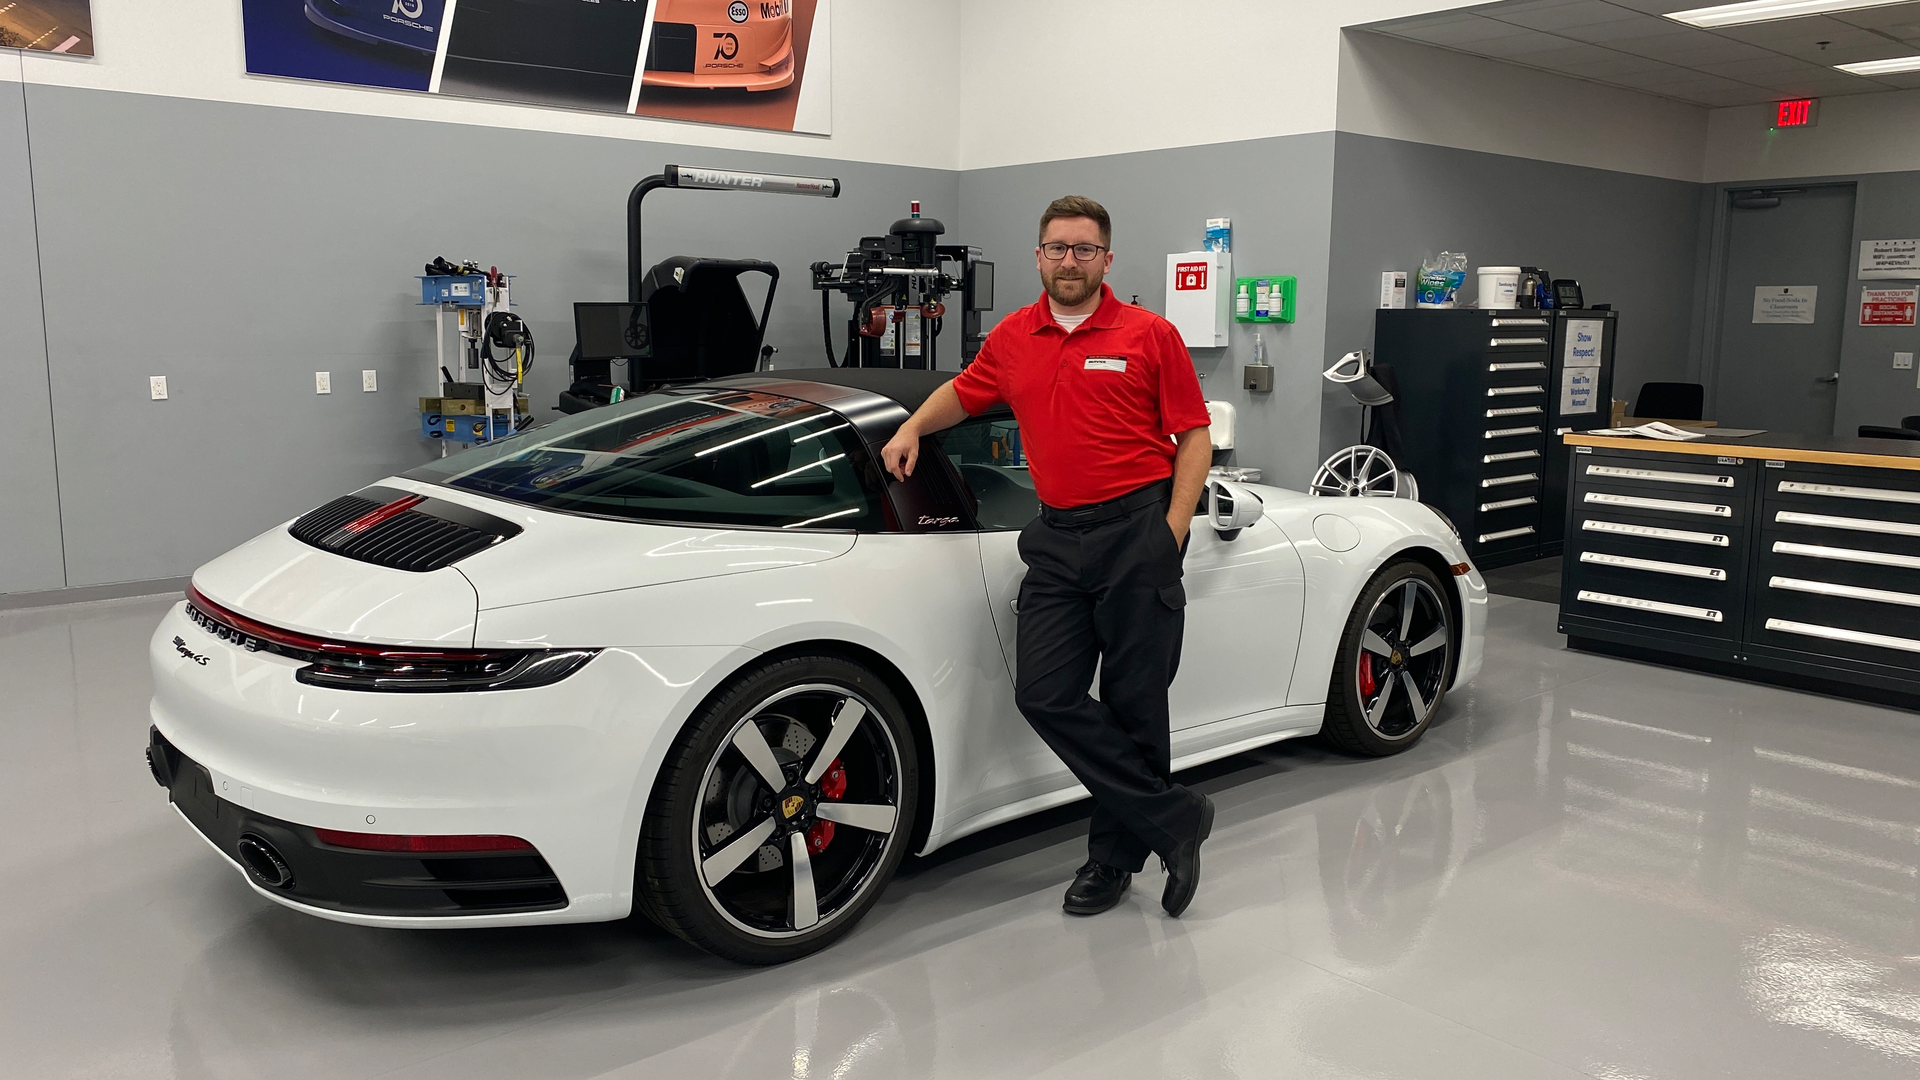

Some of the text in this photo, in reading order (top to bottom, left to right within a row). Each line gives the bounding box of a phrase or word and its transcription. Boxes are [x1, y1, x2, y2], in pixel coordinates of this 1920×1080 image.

[731, 6, 747, 17] Esso
[382, 14, 434, 32] PORSCHE
[713, 32, 739, 60] 70
[1777, 100, 1812, 127] EXIT
[693, 171, 764, 188] HUNTER
[1577, 332, 1592, 342] Show
[1573, 347, 1595, 359] Respect!
[1572, 376, 1590, 384] Read The
[1570, 388, 1590, 396] Workshop
[185, 602, 258, 653] PORSCHE
